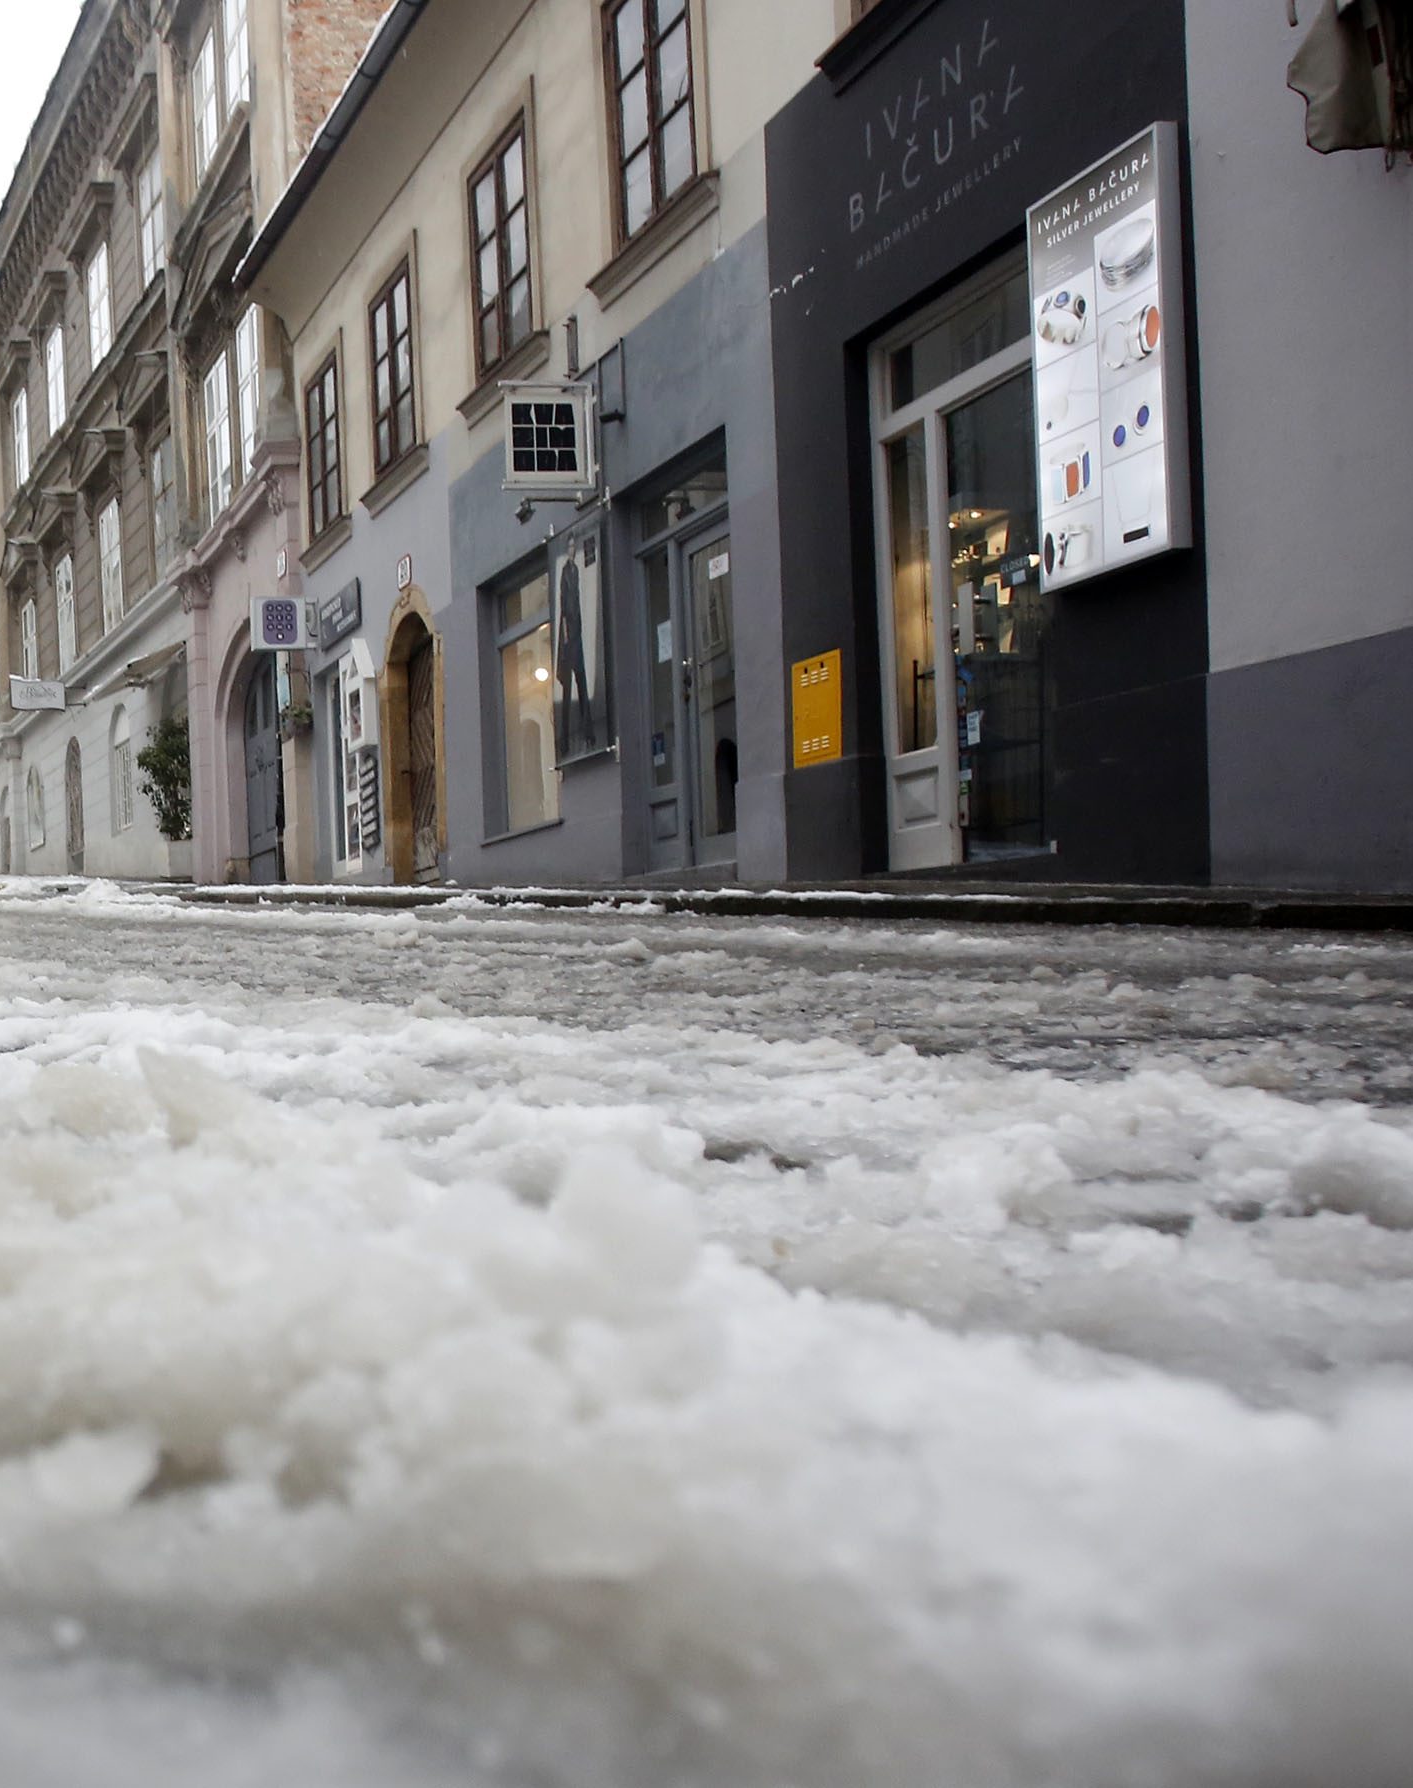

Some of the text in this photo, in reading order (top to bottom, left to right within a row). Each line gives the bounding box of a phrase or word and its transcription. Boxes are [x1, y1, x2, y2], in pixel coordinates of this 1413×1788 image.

[848, 64, 1025, 233] BAČURA
[865, 18, 998, 160] IVANA
[855, 136, 1022, 270] HANDMADE JEWELLERY
[1037, 152, 1150, 235] IVANA BAČURA
[1046, 180, 1141, 249] SILVER JEWELLERY
